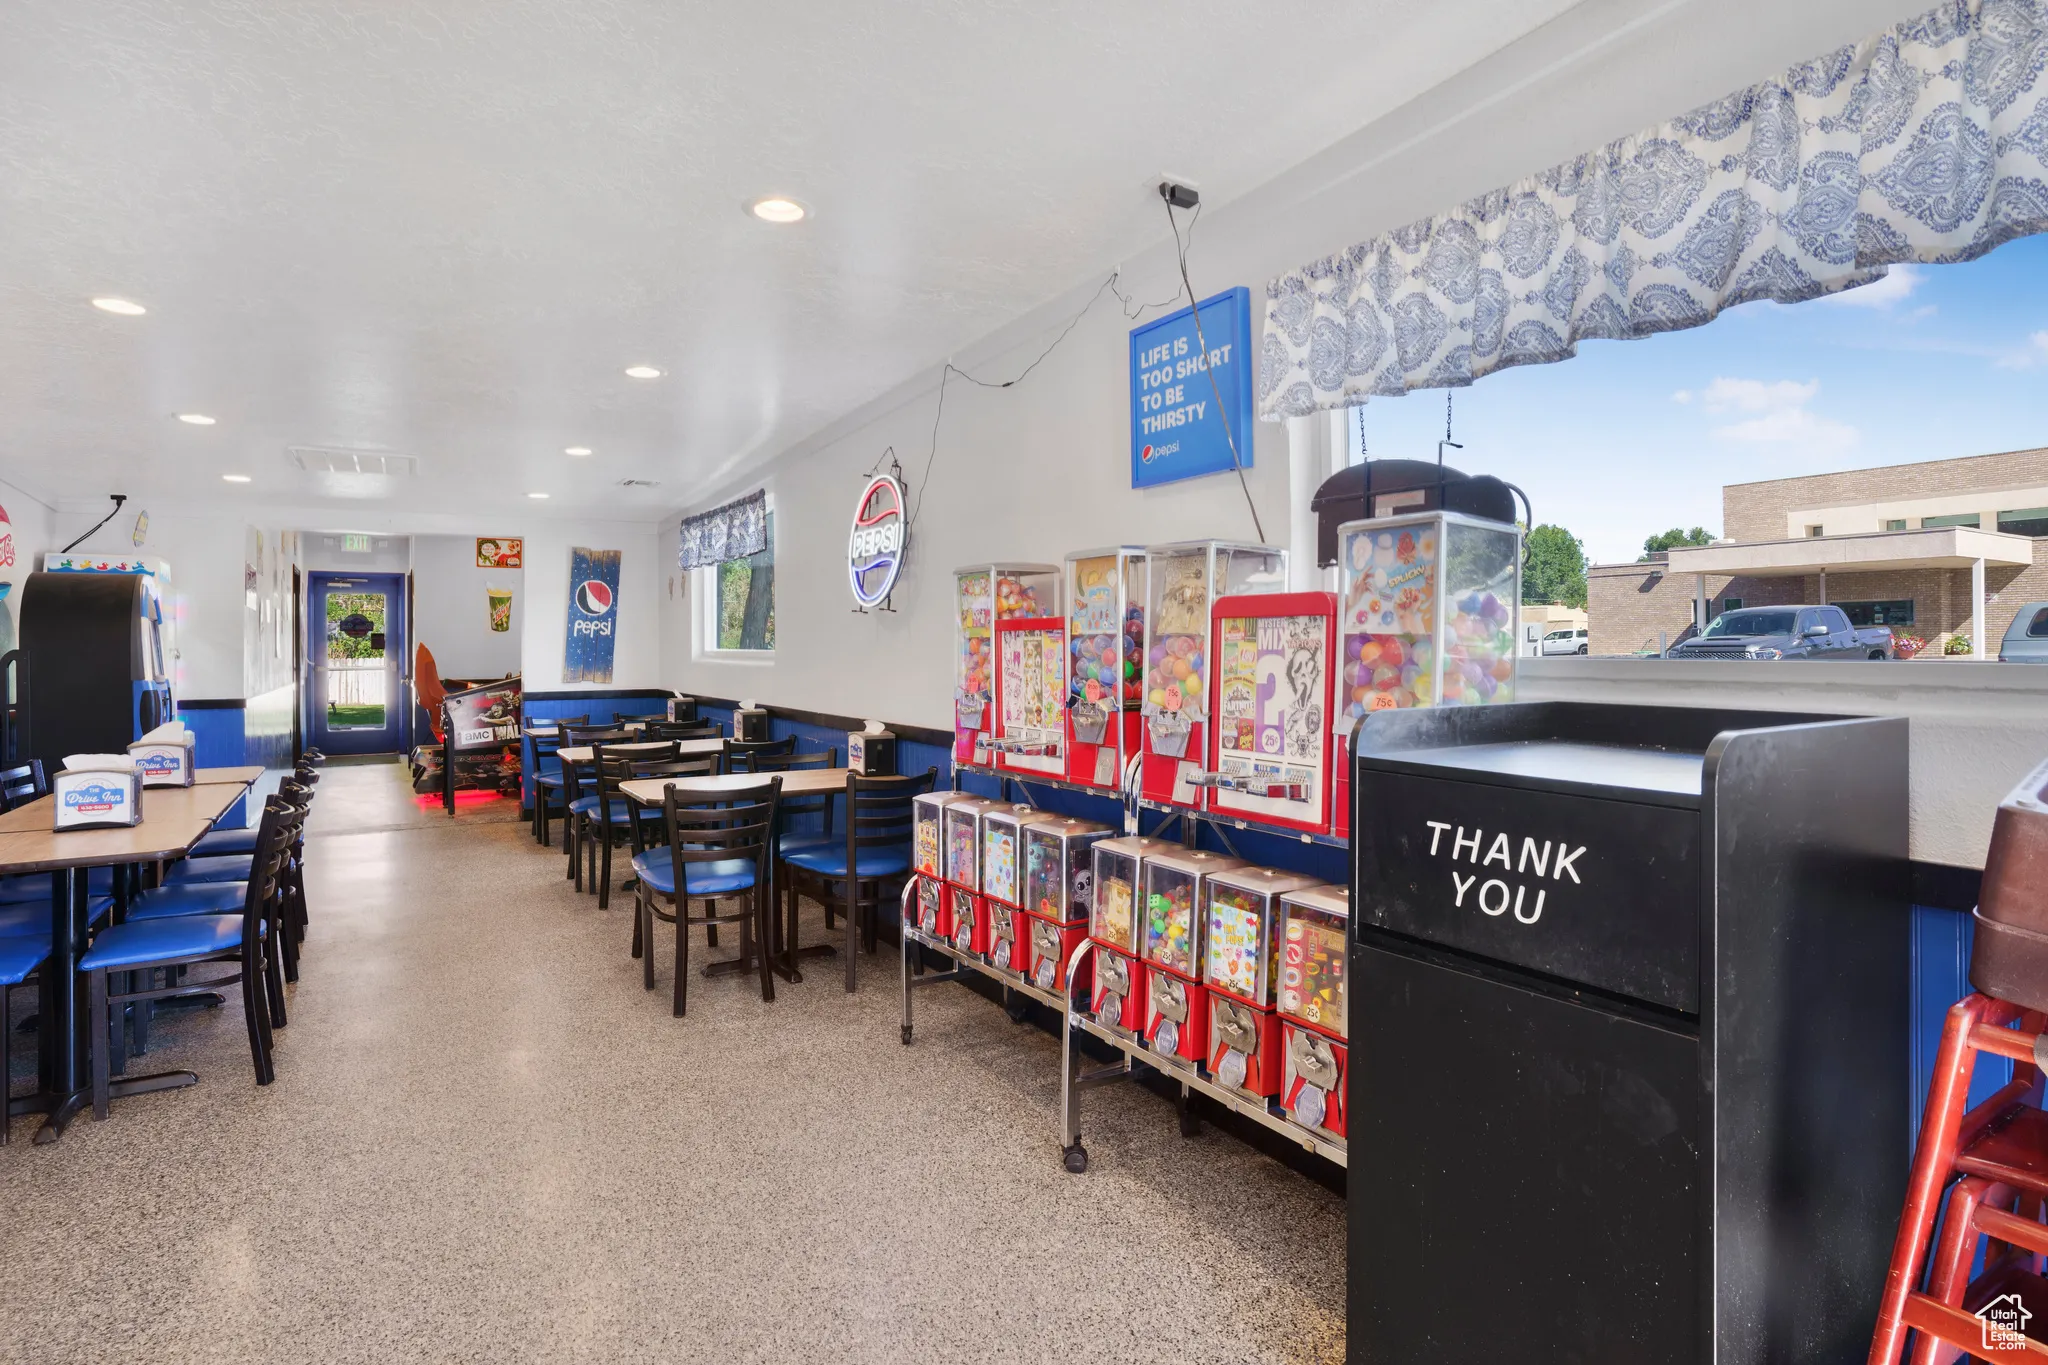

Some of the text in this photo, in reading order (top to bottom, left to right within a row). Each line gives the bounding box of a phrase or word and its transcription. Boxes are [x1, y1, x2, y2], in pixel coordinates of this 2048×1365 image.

[1141, 336, 1188, 369] LIFE IS
[1140, 344, 1232, 390] TOO SHORT
[1140, 384, 1185, 413] TO BE
[1142, 401, 1206, 435] THIRSTY
[1155, 440, 1180, 460] pepsi
[345, 535, 368, 551] EXIT
[853, 522, 900, 559] PEPSI
[574, 617, 612, 638] pepsi
[1258, 628, 1286, 650] MIX
[1168, 688, 1178, 698] 75¢
[1376, 697, 1393, 708] 75¢
[1265, 734, 1278, 746] 25¢
[137, 760, 179, 769] Drive Inn
[66, 791, 122, 804] Drive Inn
[1426, 820, 1587, 884] THANK
[1452, 871, 1546, 924] YOU
[1108, 929, 1117, 940] 25¢
[1162, 951, 1171, 962] 25¢
[1228, 978, 1239, 990] 25¢
[1306, 1006, 1318, 1019] 25¢
